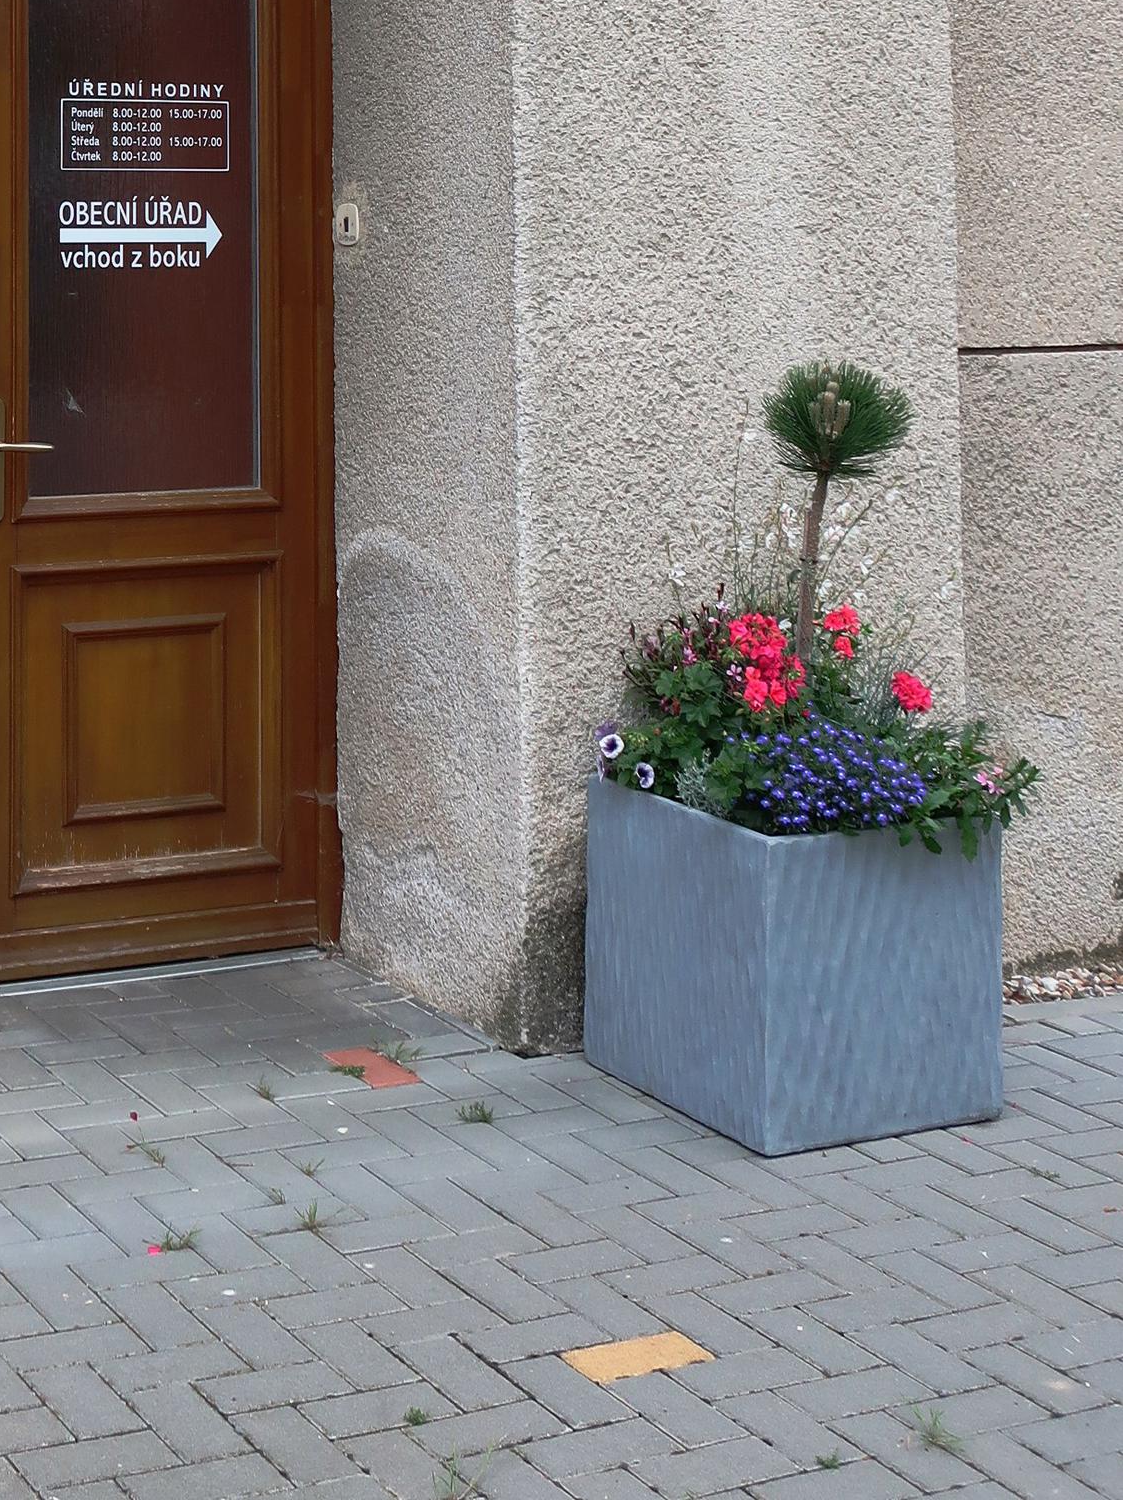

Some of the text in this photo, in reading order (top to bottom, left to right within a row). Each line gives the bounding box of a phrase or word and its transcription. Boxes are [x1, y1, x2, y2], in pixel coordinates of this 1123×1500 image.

[68, 79, 224, 98] ÚŘEDNÍ HODINY
[112, 107, 162, 119] 8.00-12.00
[169, 108, 223, 120] 15.00-17.00
[71, 119, 162, 135] Úterý 8.00-12.00
[71, 135, 223, 147] Středa 8.00-12.00 15.00-17.00
[71, 148, 162, 162] Čtvrtek 8.00-12.00
[59, 196, 202, 226] OBECNÍ ÚŘAD
[60, 244, 201, 269] vchod z boku
